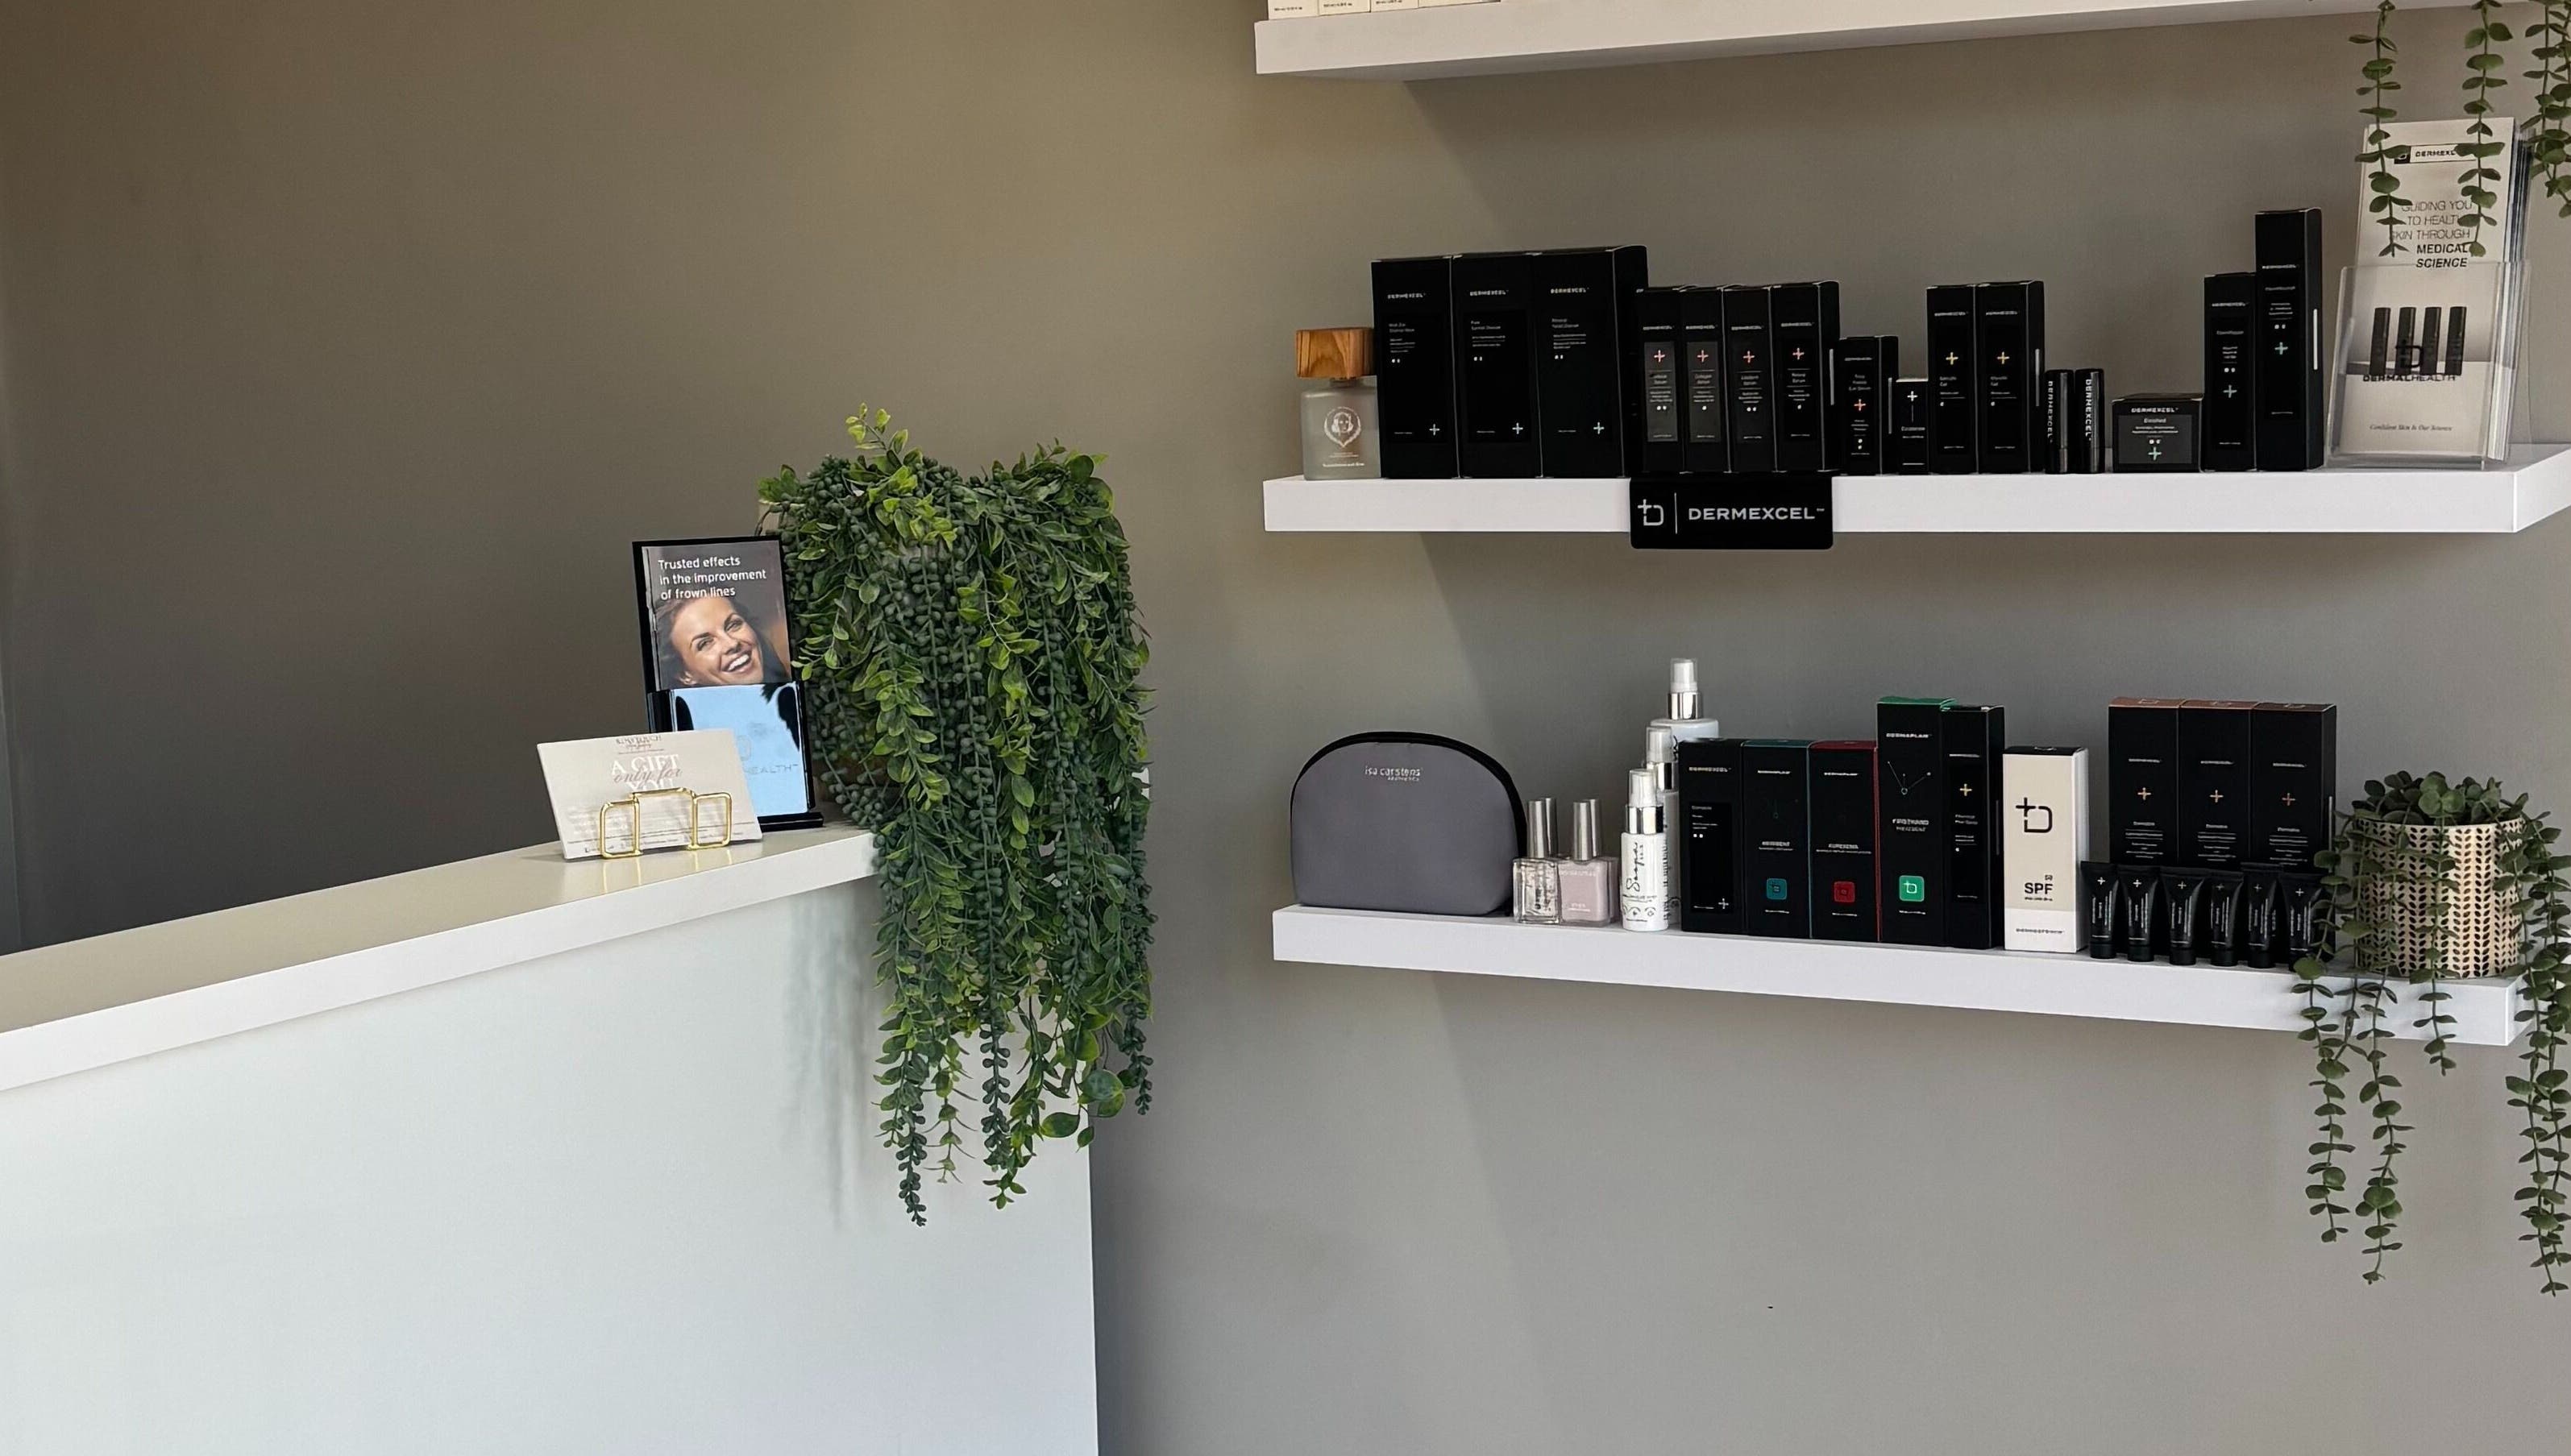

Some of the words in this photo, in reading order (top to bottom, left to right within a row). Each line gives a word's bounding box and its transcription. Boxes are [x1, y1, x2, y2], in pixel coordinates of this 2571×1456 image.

[2449, 200, 2473, 210] YOU
[2407, 215, 2422, 226] TO
[2424, 214, 2460, 226] HEALT
[2417, 228, 2470, 239] THROUGH
[2416, 243, 2469, 254] MEDICAL
[2415, 257, 2468, 268] SCIENCE
[658, 558, 700, 570] Trusted
[703, 556, 741, 568] effects
[659, 574, 670, 585] in
[672, 574, 691, 584] the
[694, 570, 766, 585] improvement
[661, 589, 671, 600] of
[675, 588, 709, 599] frown
[710, 587, 736, 598] lines
[612, 760, 626, 774] A
[631, 754, 679, 772] GIFT
[613, 769, 651, 787] only
[657, 761, 683, 785] for
[2024, 882, 2054, 895] SPF
